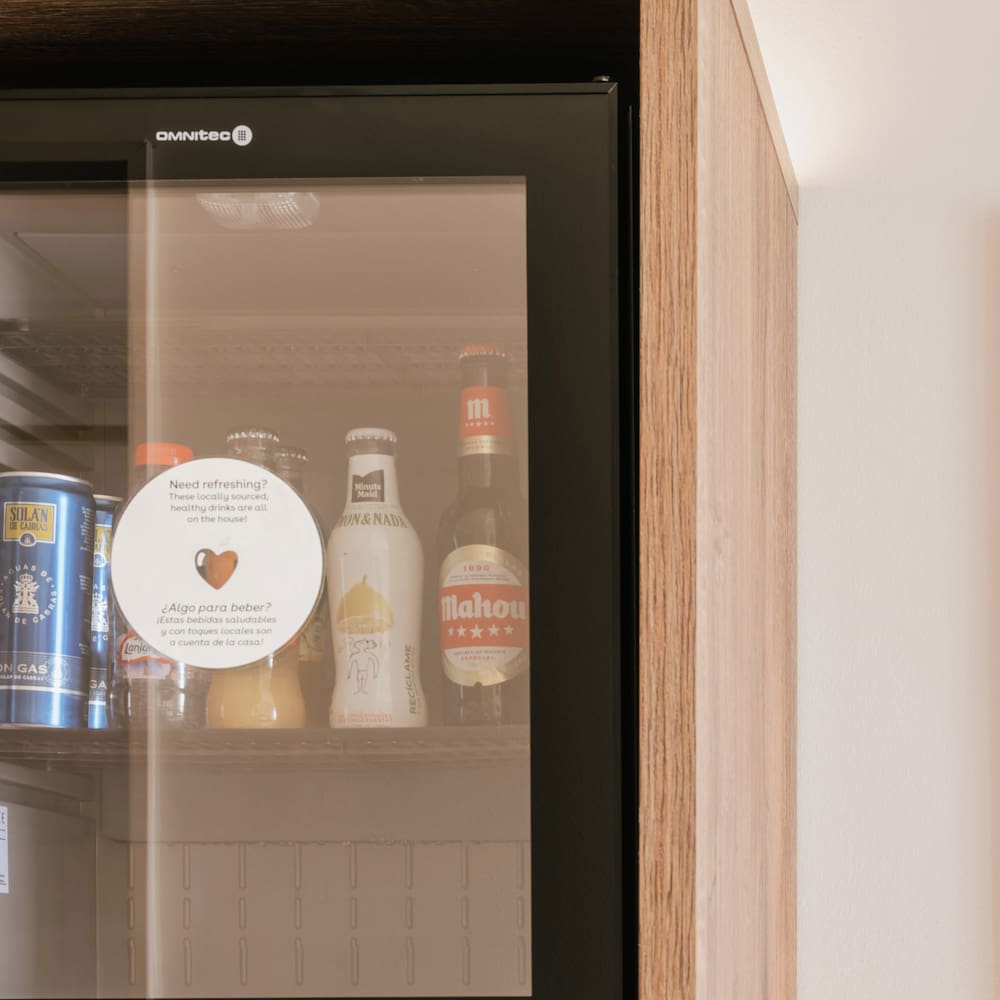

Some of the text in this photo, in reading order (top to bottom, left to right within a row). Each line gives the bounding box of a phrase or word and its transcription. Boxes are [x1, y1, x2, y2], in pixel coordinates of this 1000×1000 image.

[169, 480, 268, 491] Need refreshing?
[169, 492, 269, 502] These locally sourced,
[170, 504, 206, 513] healthy
[208, 504, 236, 512] drinks
[254, 504, 267, 512] all
[200, 515, 215, 523] the
[217, 515, 248, 523] house!
[162, 602, 272, 615] ¿Algo para beber?
[441, 592, 527, 621] Mahou
[186, 616, 222, 624] bebidas
[225, 616, 276, 624] saludables
[160, 629, 167, 637] y
[188, 628, 218, 637] toques
[178, 639, 210, 647] cuenta
[237, 638, 264, 646] casa!
[17, 663, 48, 674] GAS
